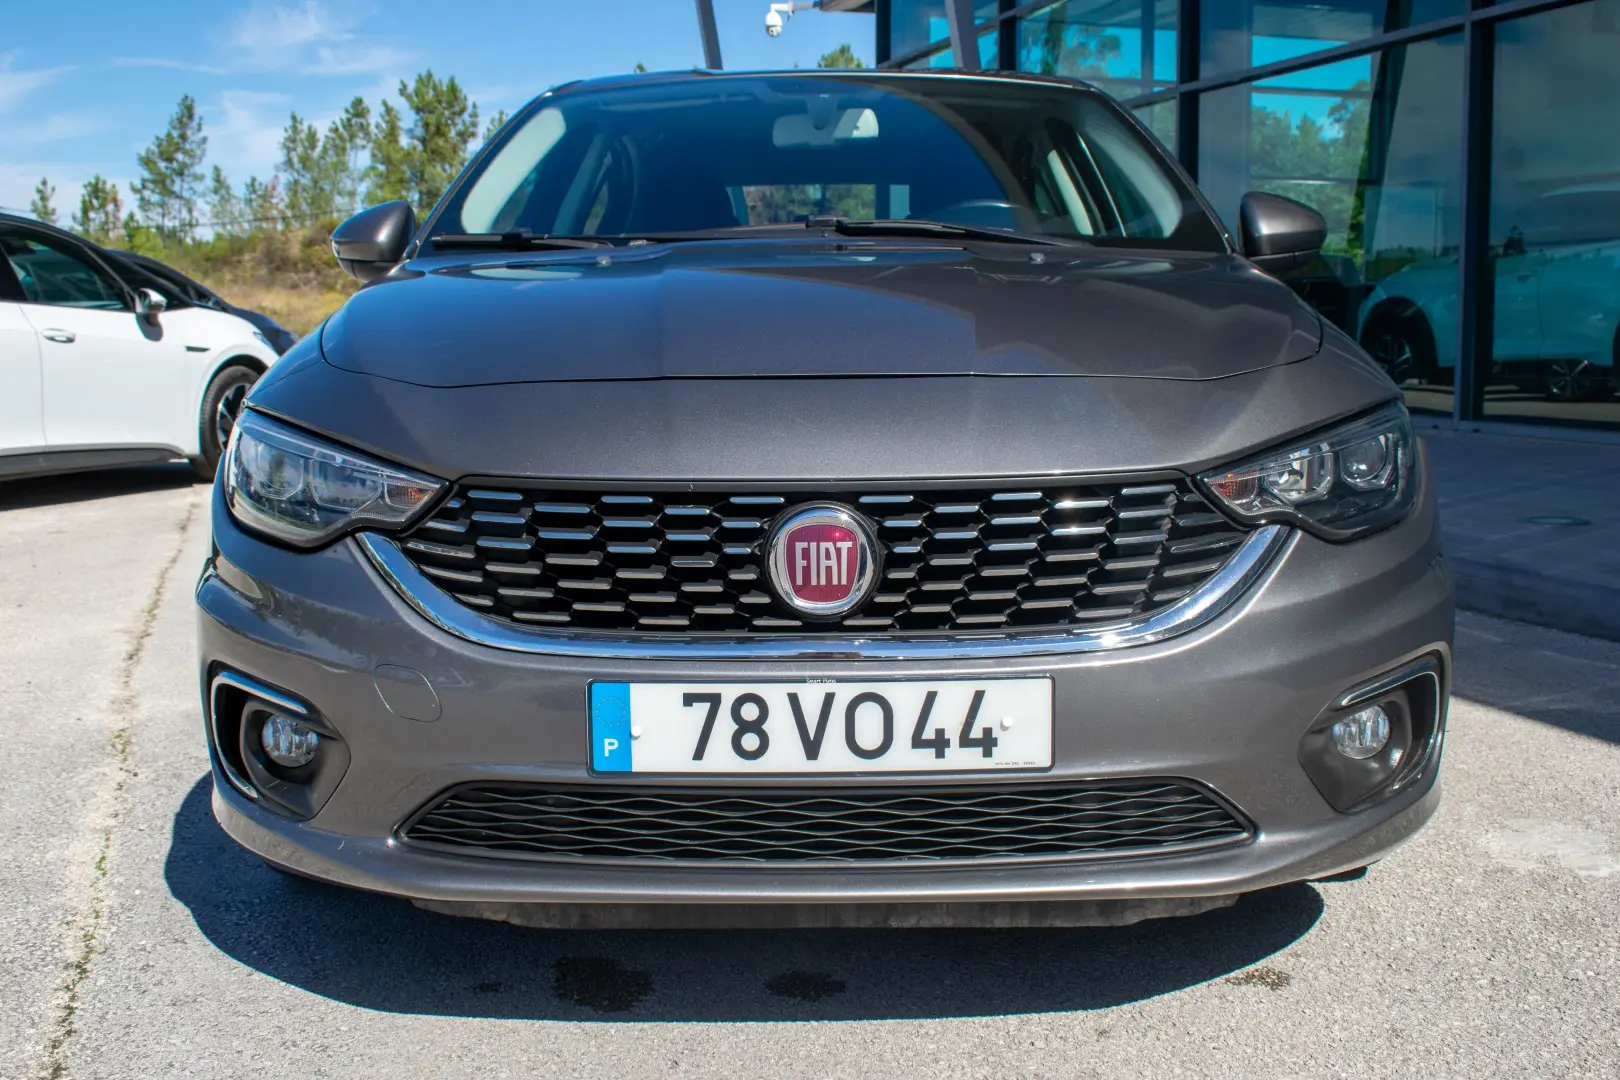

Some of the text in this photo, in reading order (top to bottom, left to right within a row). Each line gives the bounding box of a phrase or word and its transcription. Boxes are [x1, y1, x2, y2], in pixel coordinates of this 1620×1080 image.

[795, 541, 853, 586] FIAT
[604, 738, 619, 757] P
[682, 690, 998, 761] 78 VO 44
